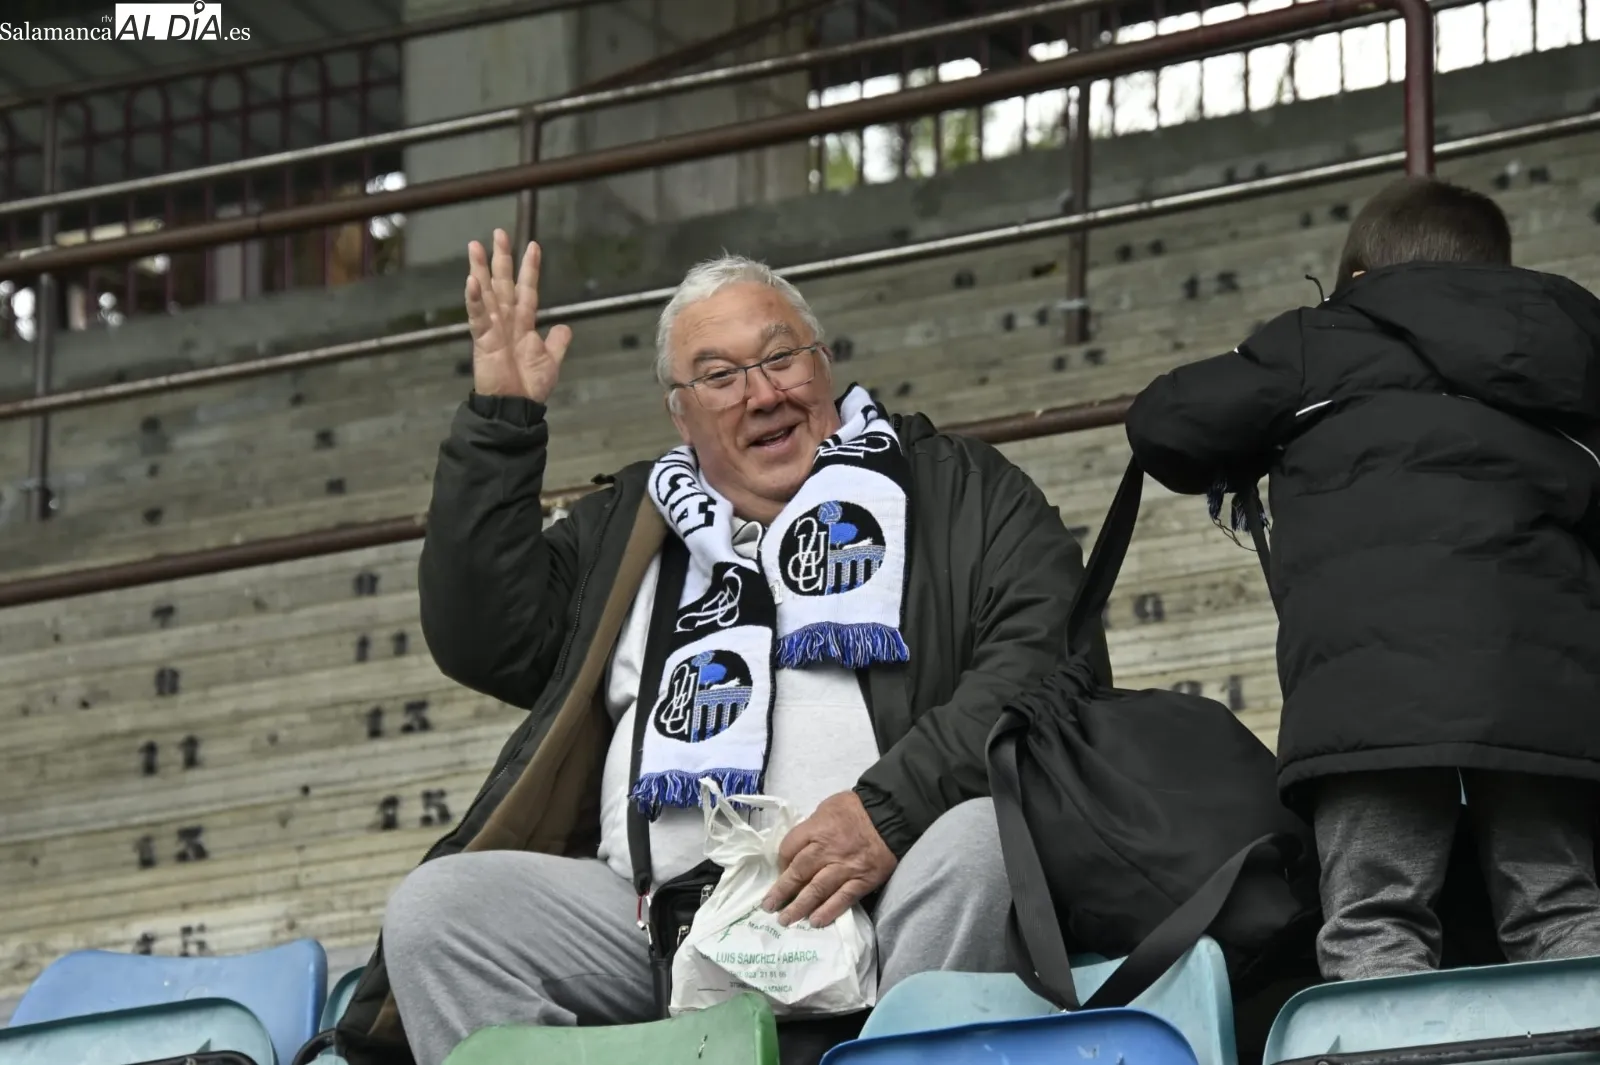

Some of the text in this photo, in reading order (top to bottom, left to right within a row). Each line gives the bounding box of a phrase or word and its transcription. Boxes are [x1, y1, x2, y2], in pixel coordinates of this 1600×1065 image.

[716, 951, 736, 964] LUIS
[737, 952, 776, 965] SANCHEZ
[782, 950, 819, 964] ABARCA
